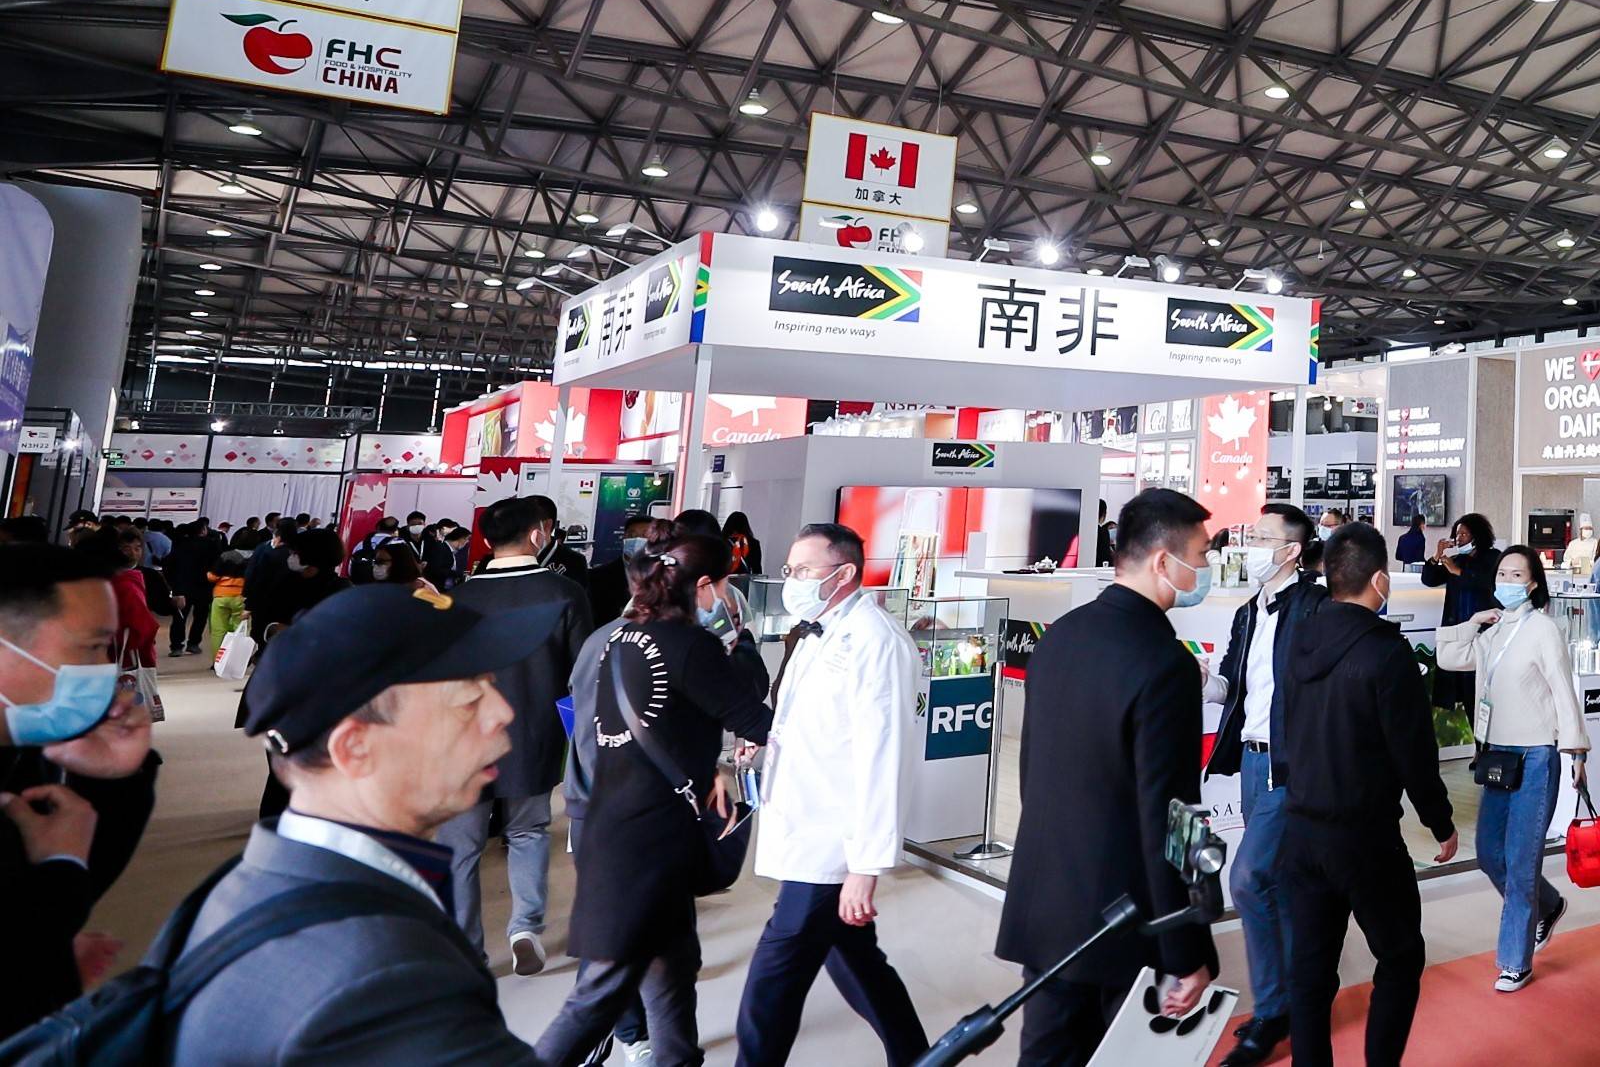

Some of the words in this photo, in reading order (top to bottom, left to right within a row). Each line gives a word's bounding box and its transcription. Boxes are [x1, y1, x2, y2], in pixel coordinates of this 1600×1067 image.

[325, 38, 402, 69] FHC
[322, 67, 399, 94] CHINA
[324, 59, 348, 68] FOOD
[358, 65, 412, 79] HOSPITALITY
[855, 186, 902, 205] 加拿大
[777, 269, 831, 295] South
[833, 275, 886, 300] Africa
[774, 320, 823, 335] Inspiring
[825, 327, 848, 335] new
[849, 328, 877, 339] ways
[977, 278, 1119, 356] 南非
[1170, 308, 1209, 331] South
[1210, 312, 1248, 333] Africa
[1169, 351, 1204, 365] Inspiring
[1206, 354, 1222, 363] new
[1223, 356, 1242, 365] ways
[1545, 356, 1576, 382] WE
[1211, 450, 1254, 464] Canada
[931, 701, 992, 734] RFG
